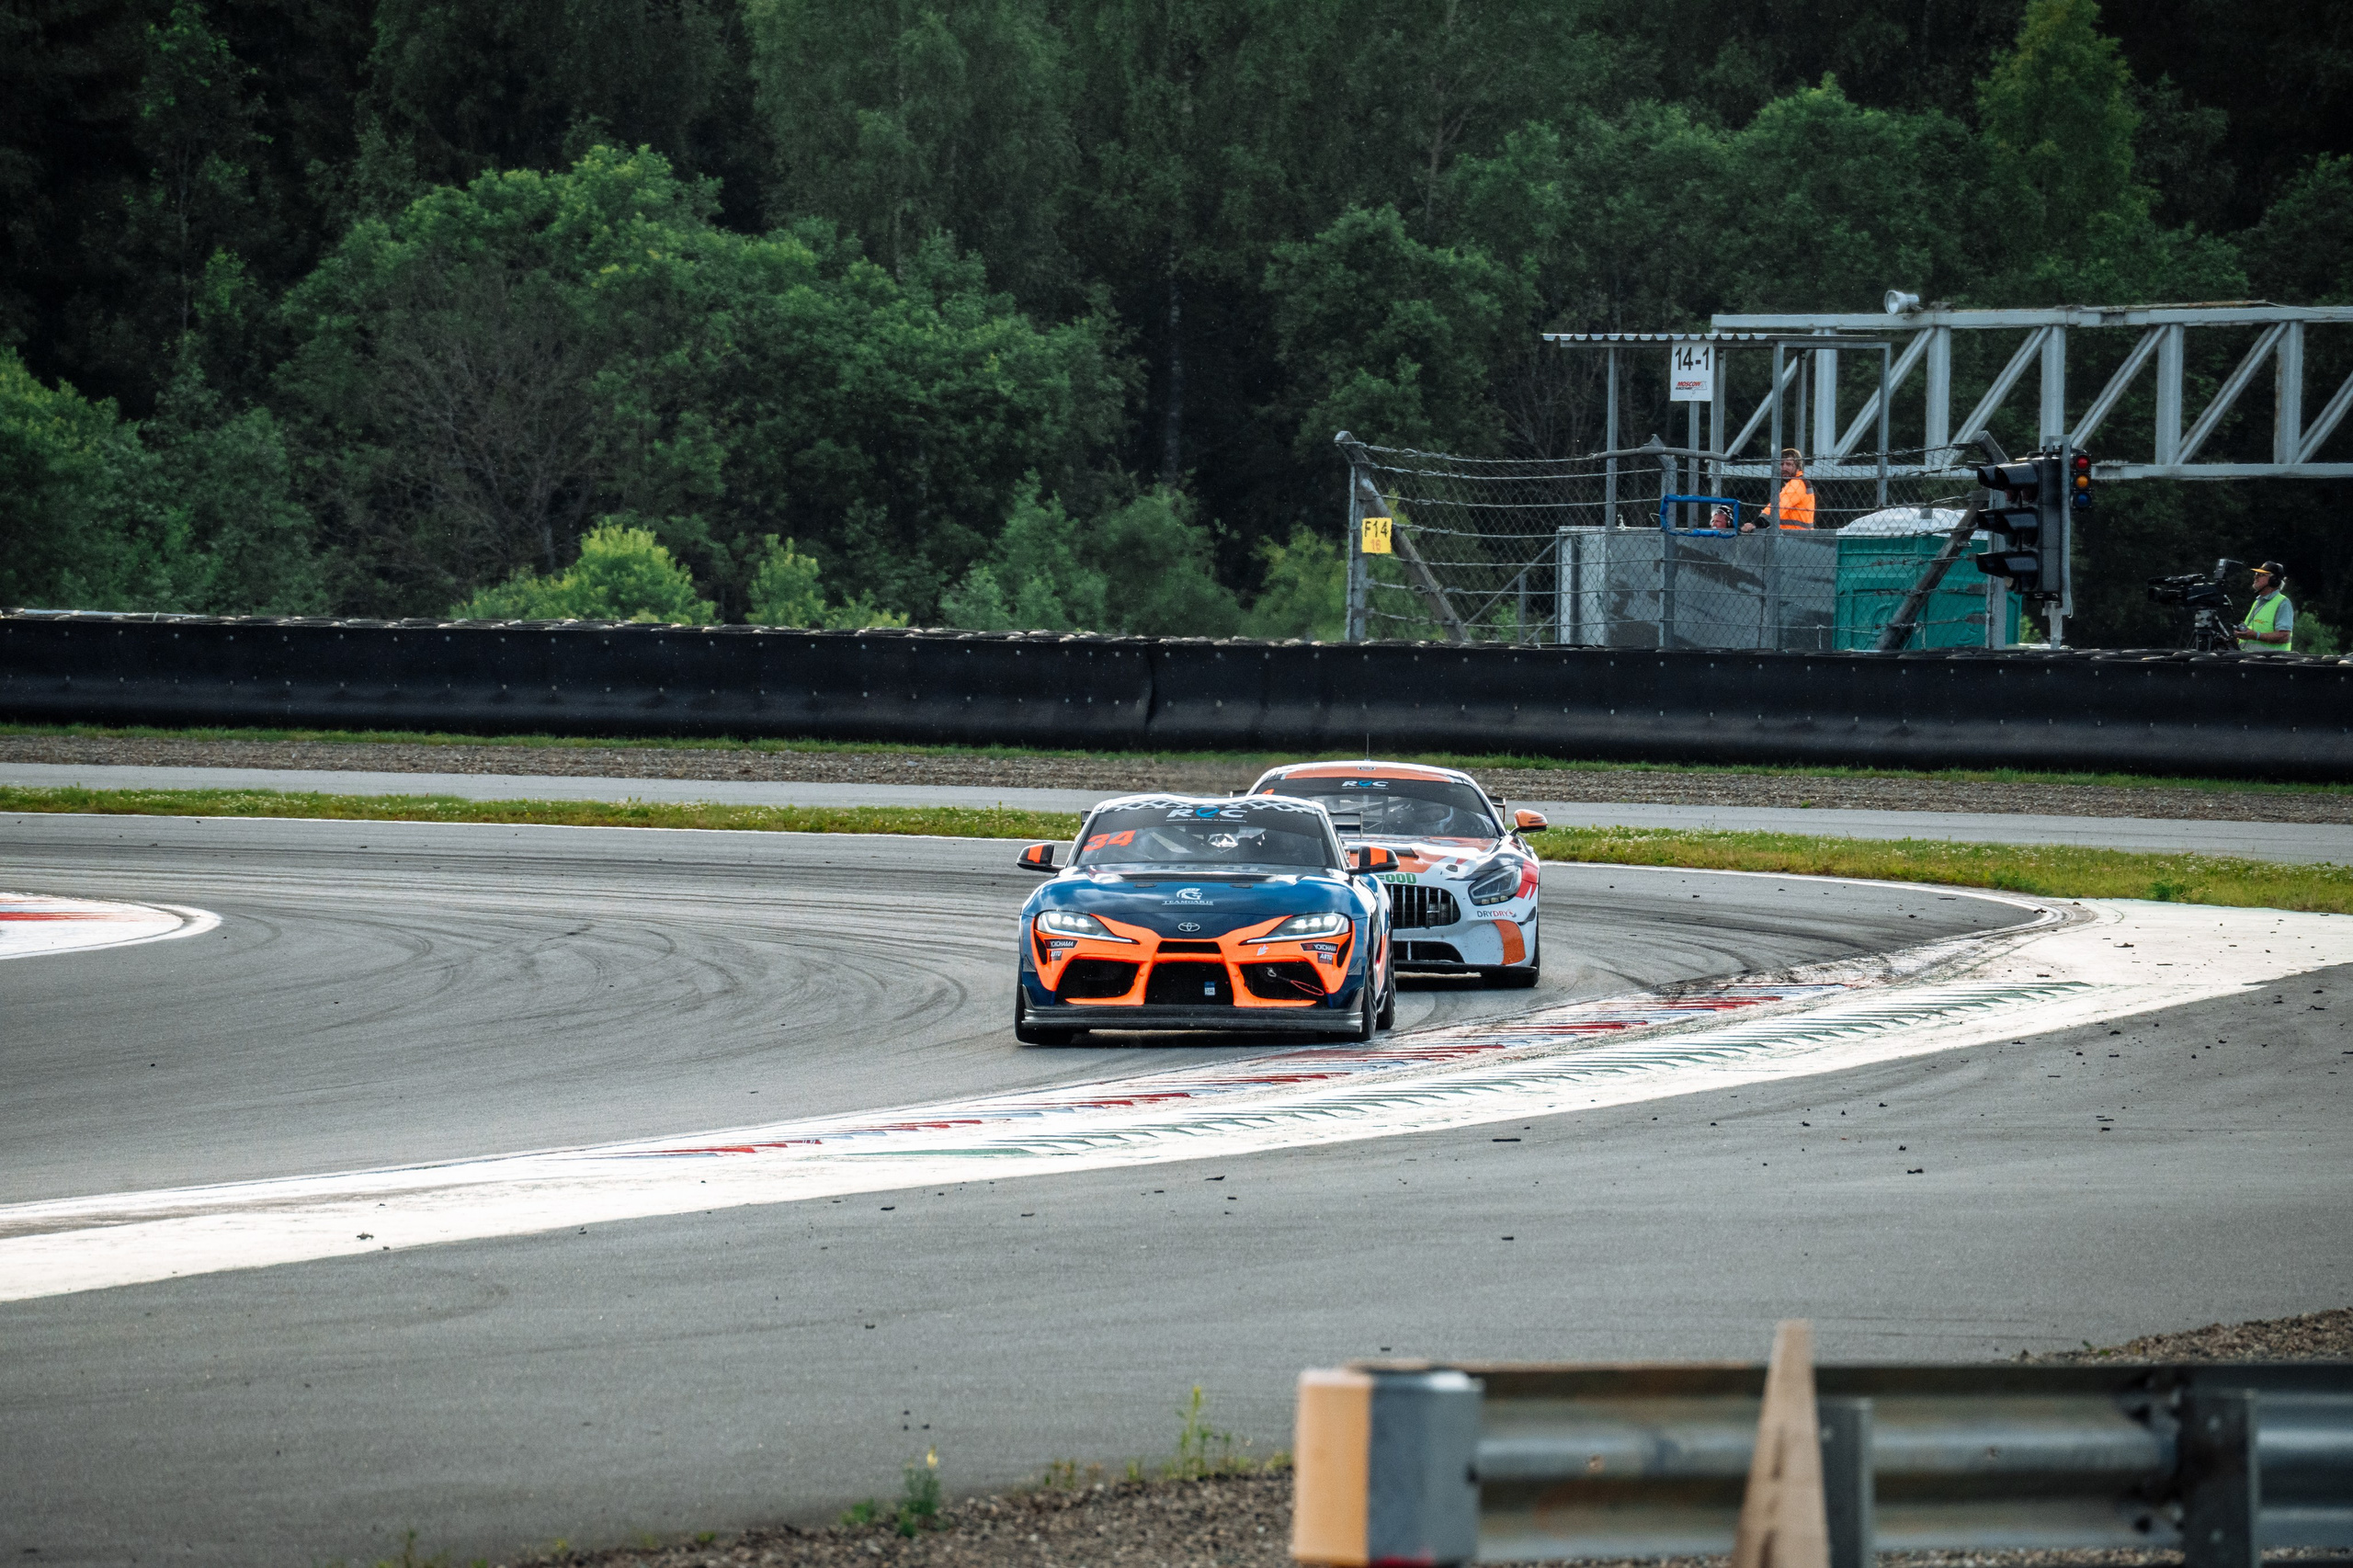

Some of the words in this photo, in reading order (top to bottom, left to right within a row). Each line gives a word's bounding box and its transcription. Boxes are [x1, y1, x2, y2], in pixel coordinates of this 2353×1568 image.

[1675, 347, 1710, 370] 14-1
[1365, 520, 1388, 538] F14
[1083, 830, 1136, 851] 34
[1313, 944, 1336, 952] YOKOHAMA
